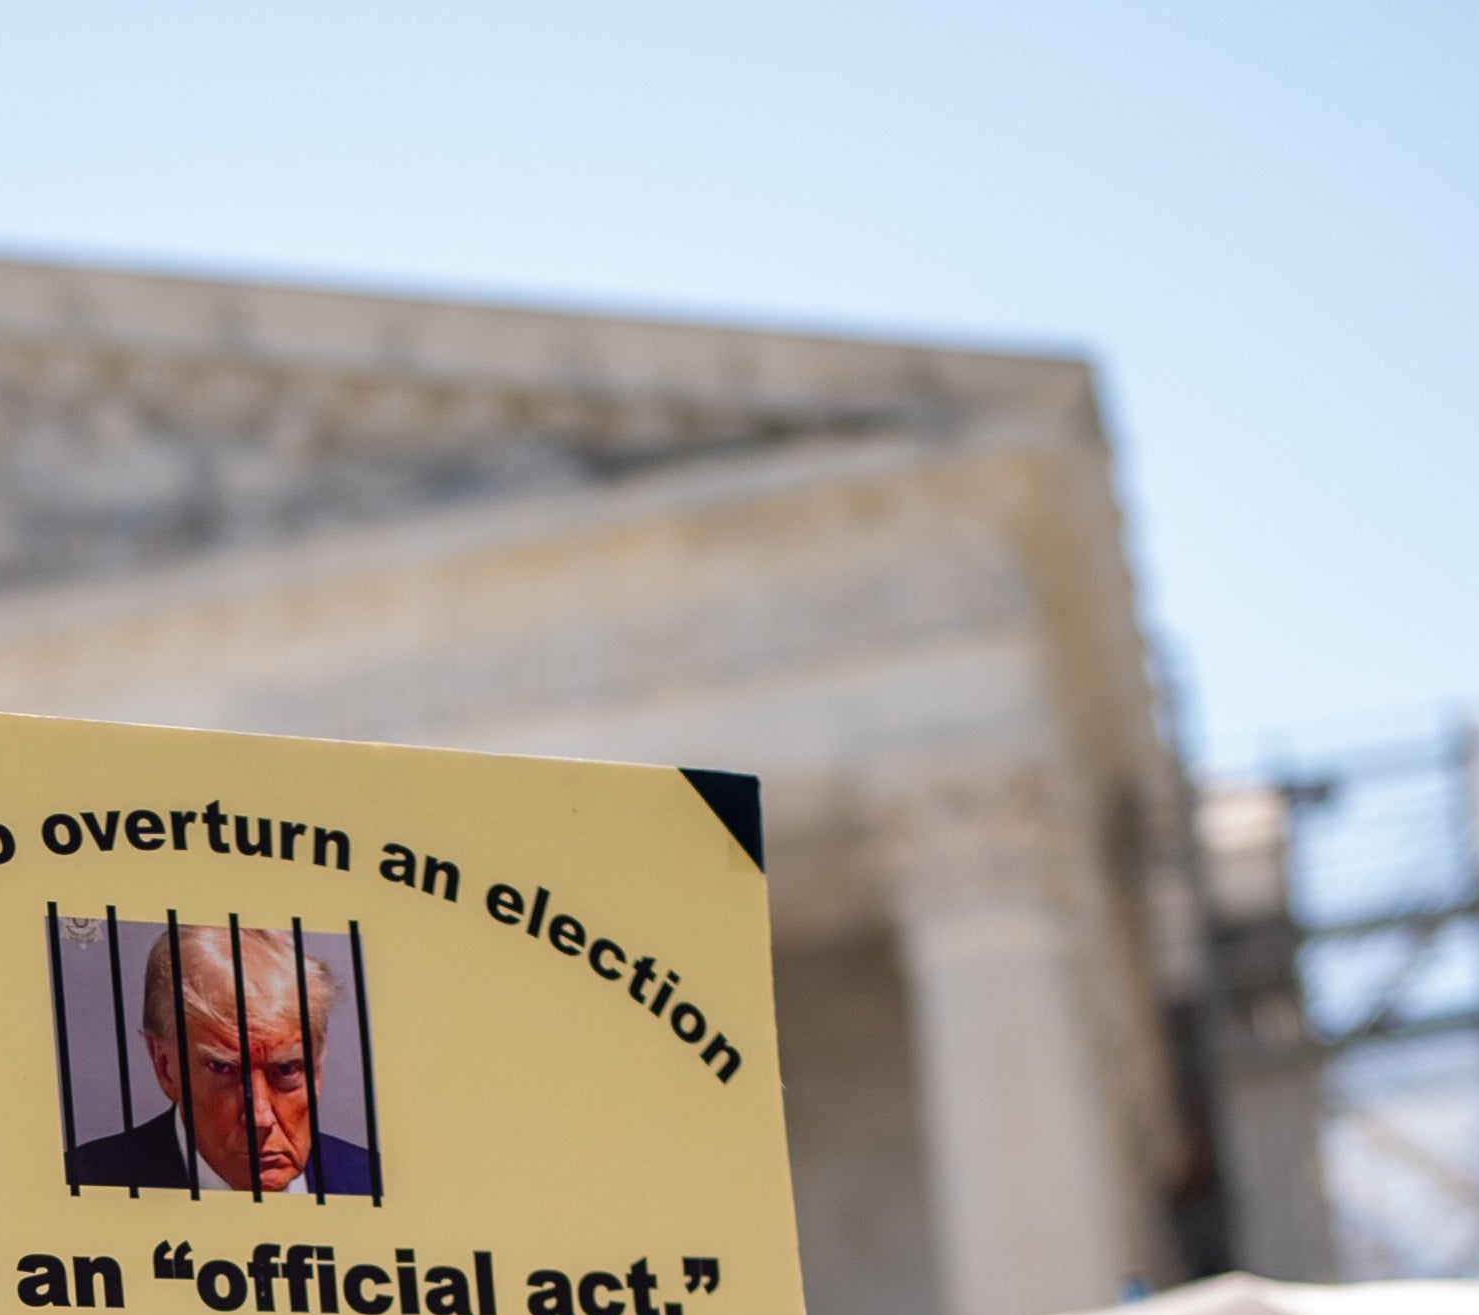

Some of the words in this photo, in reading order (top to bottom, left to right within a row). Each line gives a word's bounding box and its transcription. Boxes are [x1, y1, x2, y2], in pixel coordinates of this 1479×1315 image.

[41, 799, 351, 872] overturn
[379, 842, 460, 903] an
[485, 883, 742, 1085] election
[16, 1253, 125, 1309] an
